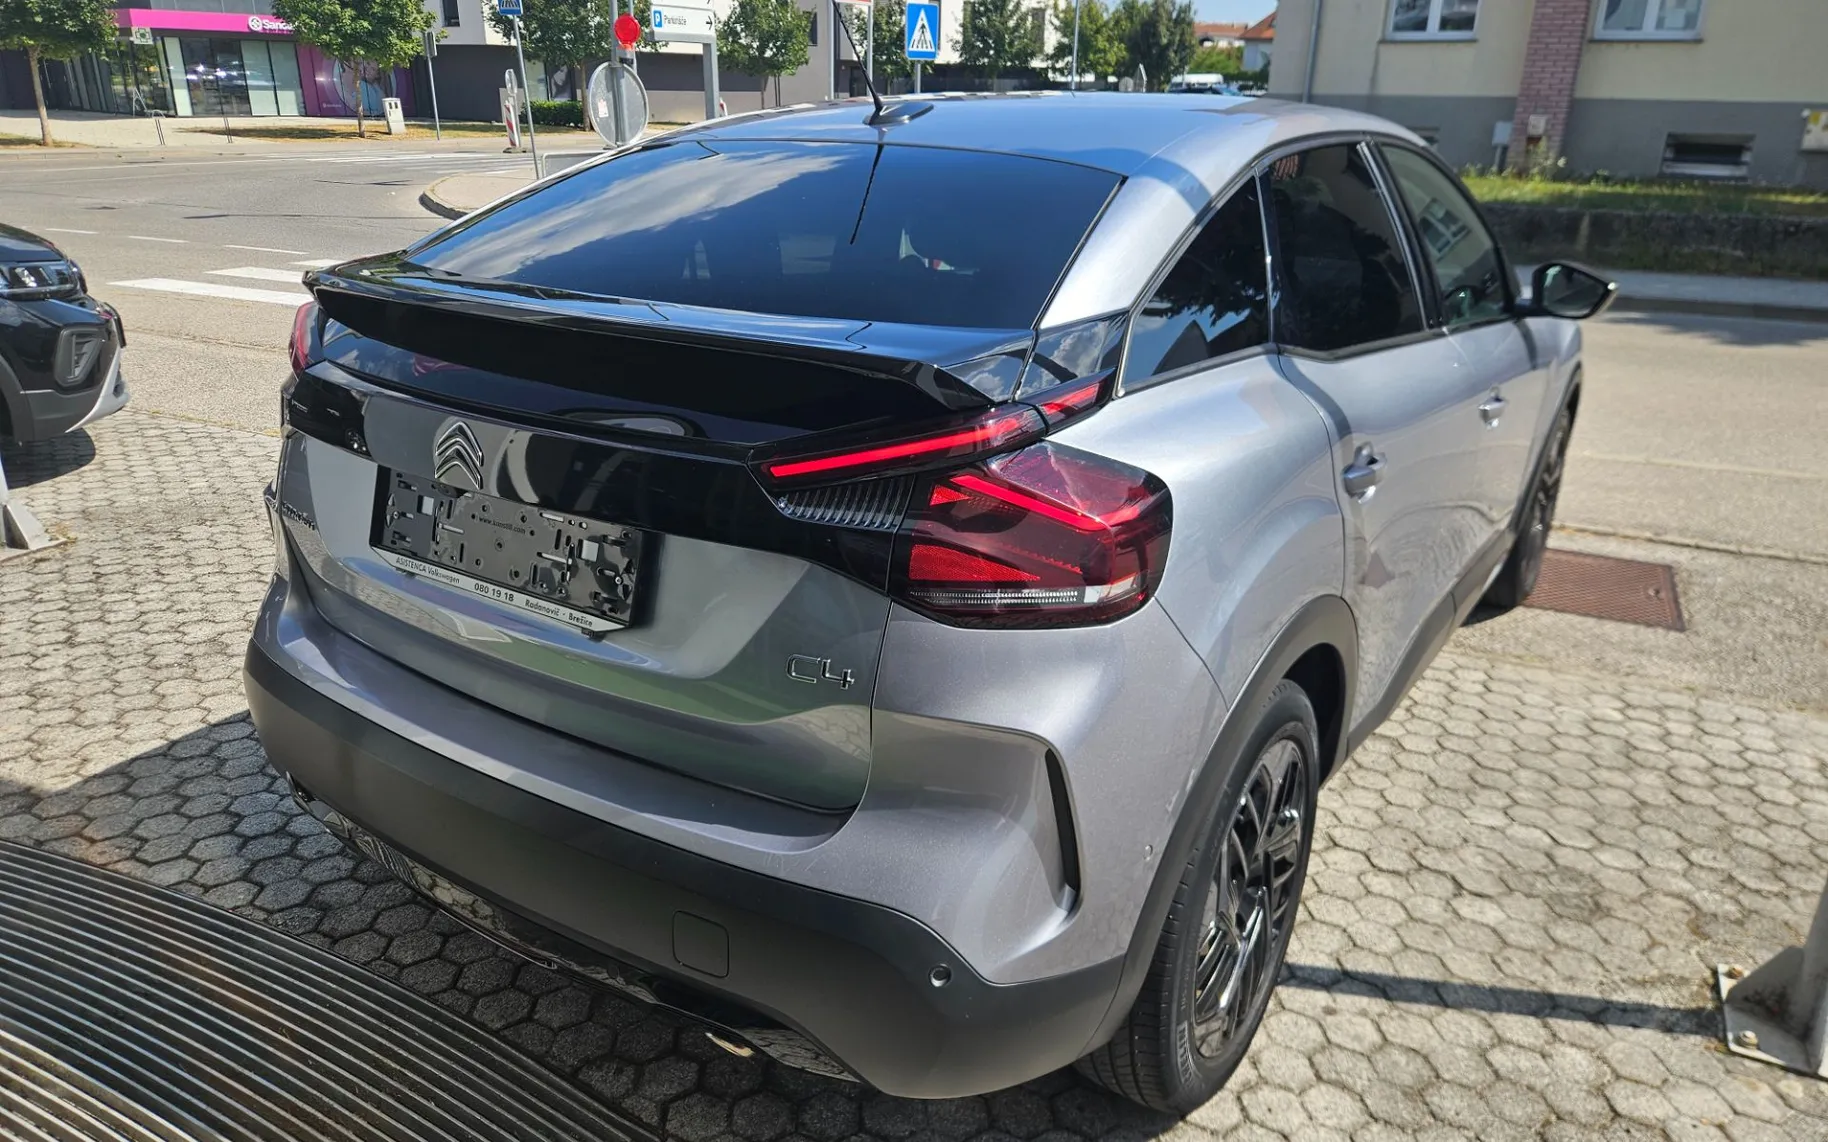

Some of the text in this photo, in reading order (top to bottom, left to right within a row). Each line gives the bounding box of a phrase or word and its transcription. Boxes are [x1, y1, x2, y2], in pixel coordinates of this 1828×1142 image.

[396, 557, 427, 573] ASISTENCA
[428, 566, 460, 584] Volkswagen
[474, 583, 489, 594] 080
[492, 588, 502, 598] 19
[504, 592, 515, 602] 18
[568, 612, 593, 627] Brežice
[786, 653, 855, 690] C4
